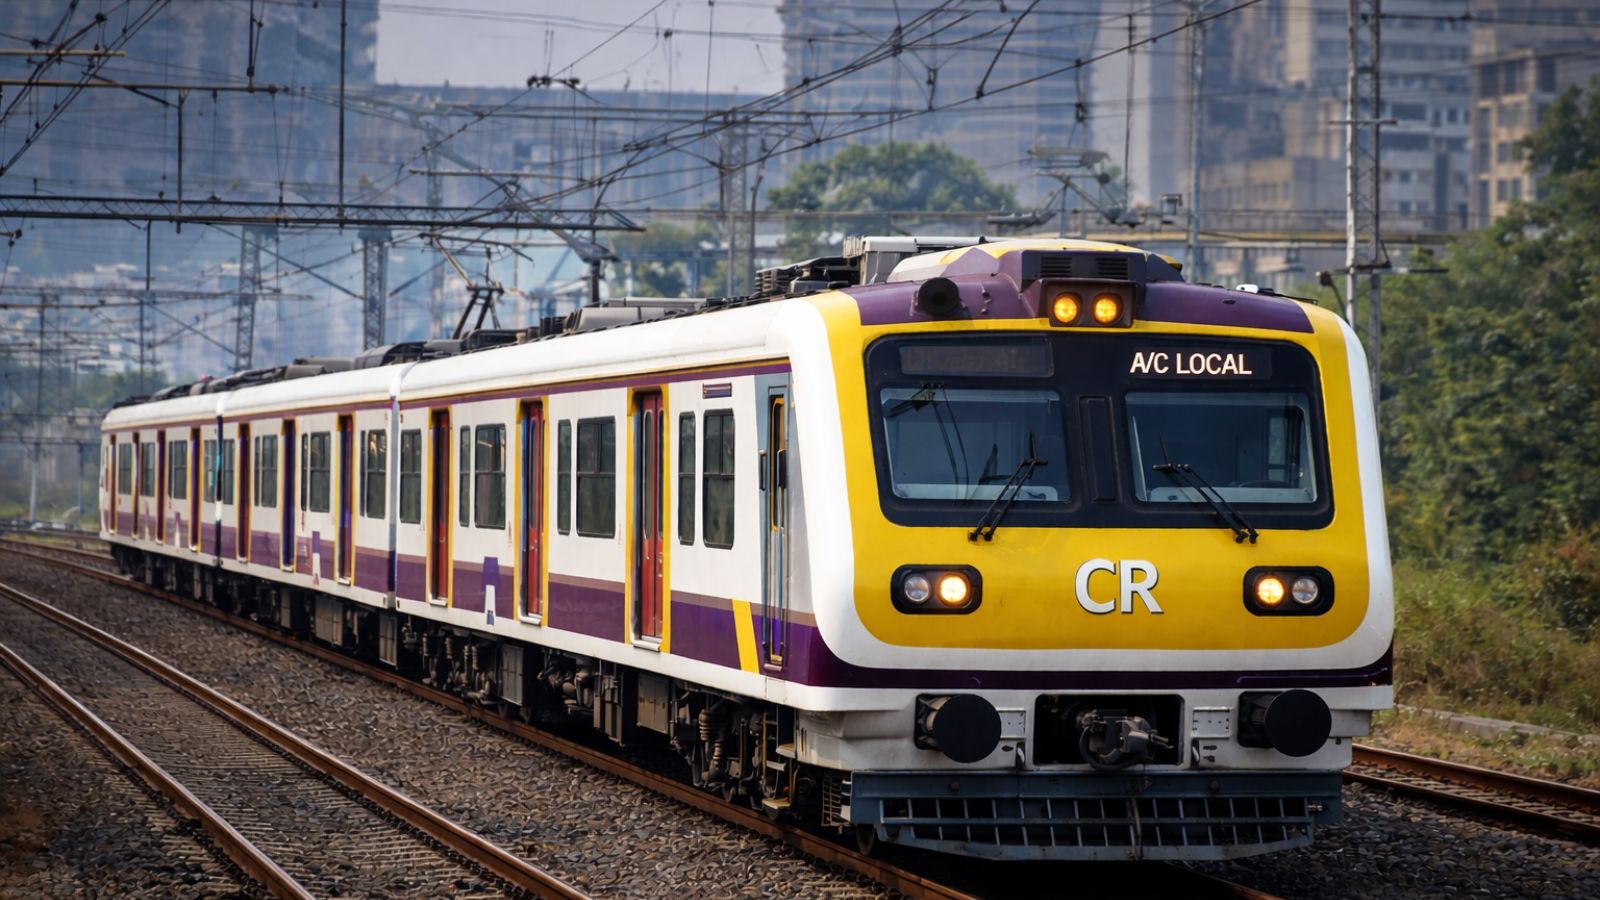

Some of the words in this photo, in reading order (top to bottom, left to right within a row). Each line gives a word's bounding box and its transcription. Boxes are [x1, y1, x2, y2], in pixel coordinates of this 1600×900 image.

[1130, 352, 1168, 373] A/C
[1176, 353, 1252, 374] LOCAL
[1075, 558, 1163, 614] CR
